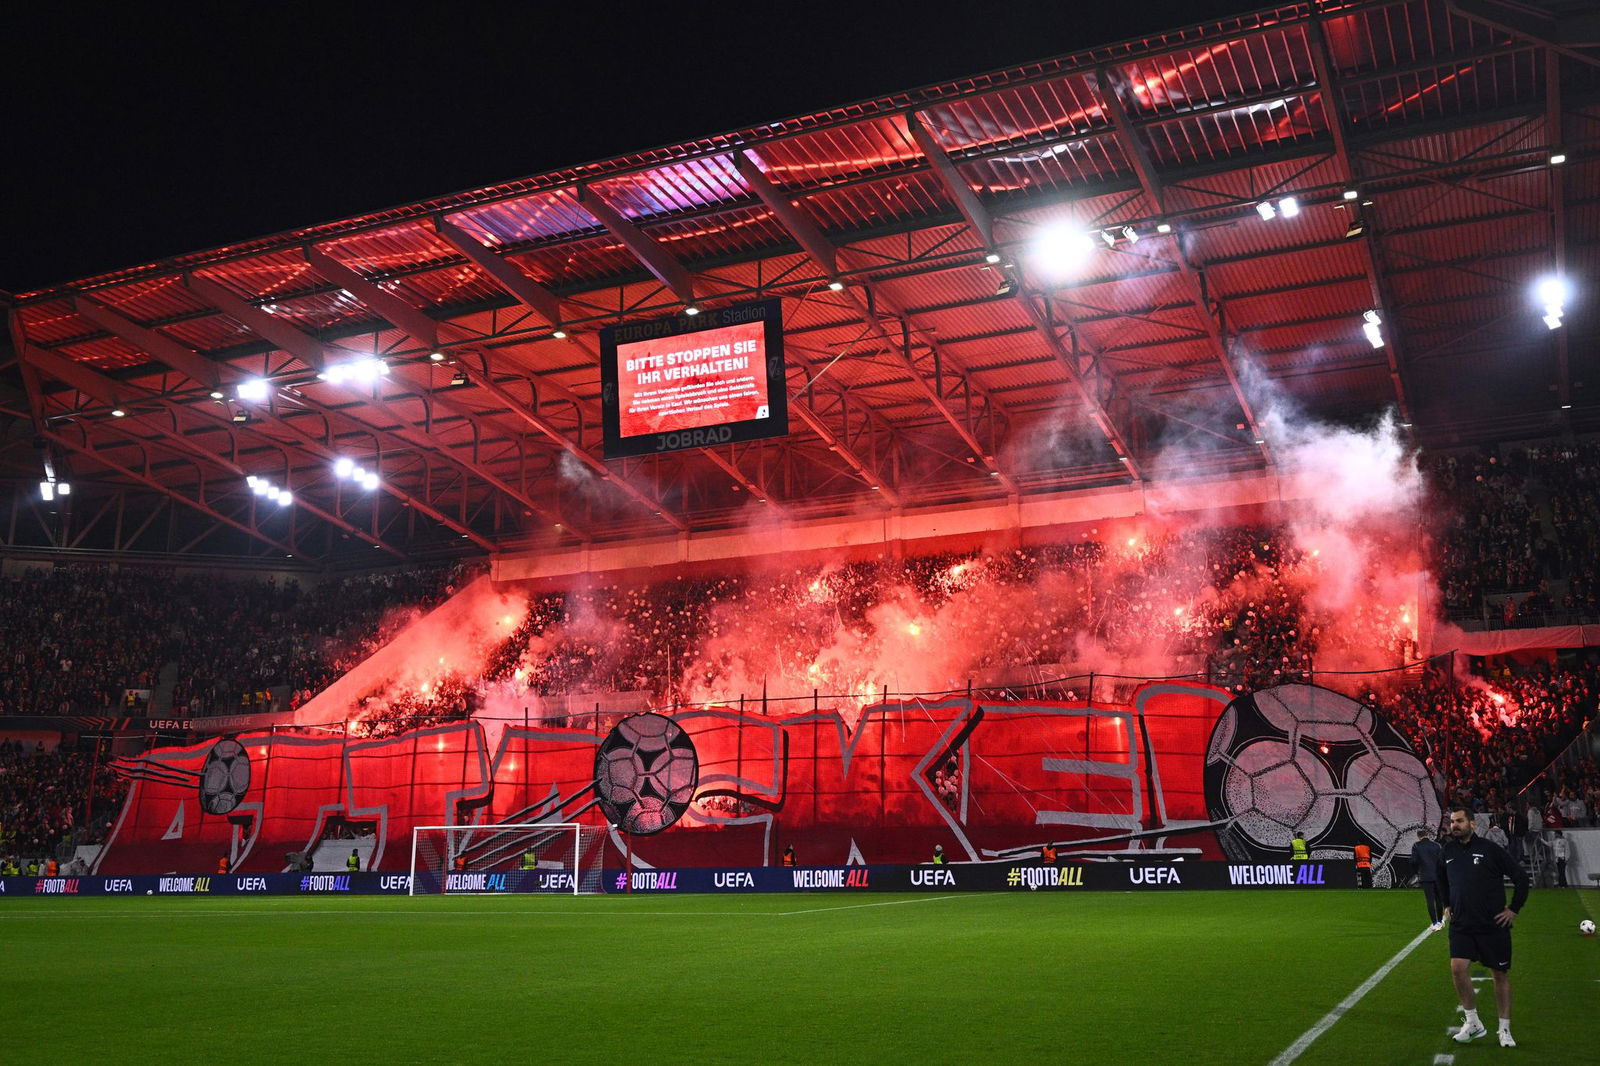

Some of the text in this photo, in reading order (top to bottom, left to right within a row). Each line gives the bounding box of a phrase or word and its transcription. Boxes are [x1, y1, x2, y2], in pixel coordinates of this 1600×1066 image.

[614, 306, 766, 342] EUROPA PARK Stadion
[626, 339, 757, 371] BITTE STOPPEN SIE
[637, 356, 749, 385] IHR VERHALTEN!
[656, 426, 732, 451] JOBRAD
[149, 719, 179, 729] UEFA
[220, 716, 251, 728] LEAGUE
[300, 875, 350, 891] #FOOTBALL
[380, 875, 412, 890] UEFA
[445, 873, 506, 891] WELCOME ALL
[615, 872, 677, 889] #OOTBALL
[714, 872, 755, 888] UEFA
[793, 869, 869, 888] WELCOME ALL
[910, 869, 956, 886] UEFA
[1006, 867, 1084, 887] #FOOTBALL
[1129, 867, 1181, 885] UEFA
[1228, 864, 1326, 885] WELCOME ALL
[34, 879, 79, 894] #FOOTBALL
[104, 879, 133, 892] UEFA
[159, 877, 210, 892] WELCOME ALL
[237, 877, 267, 891] UEFA
